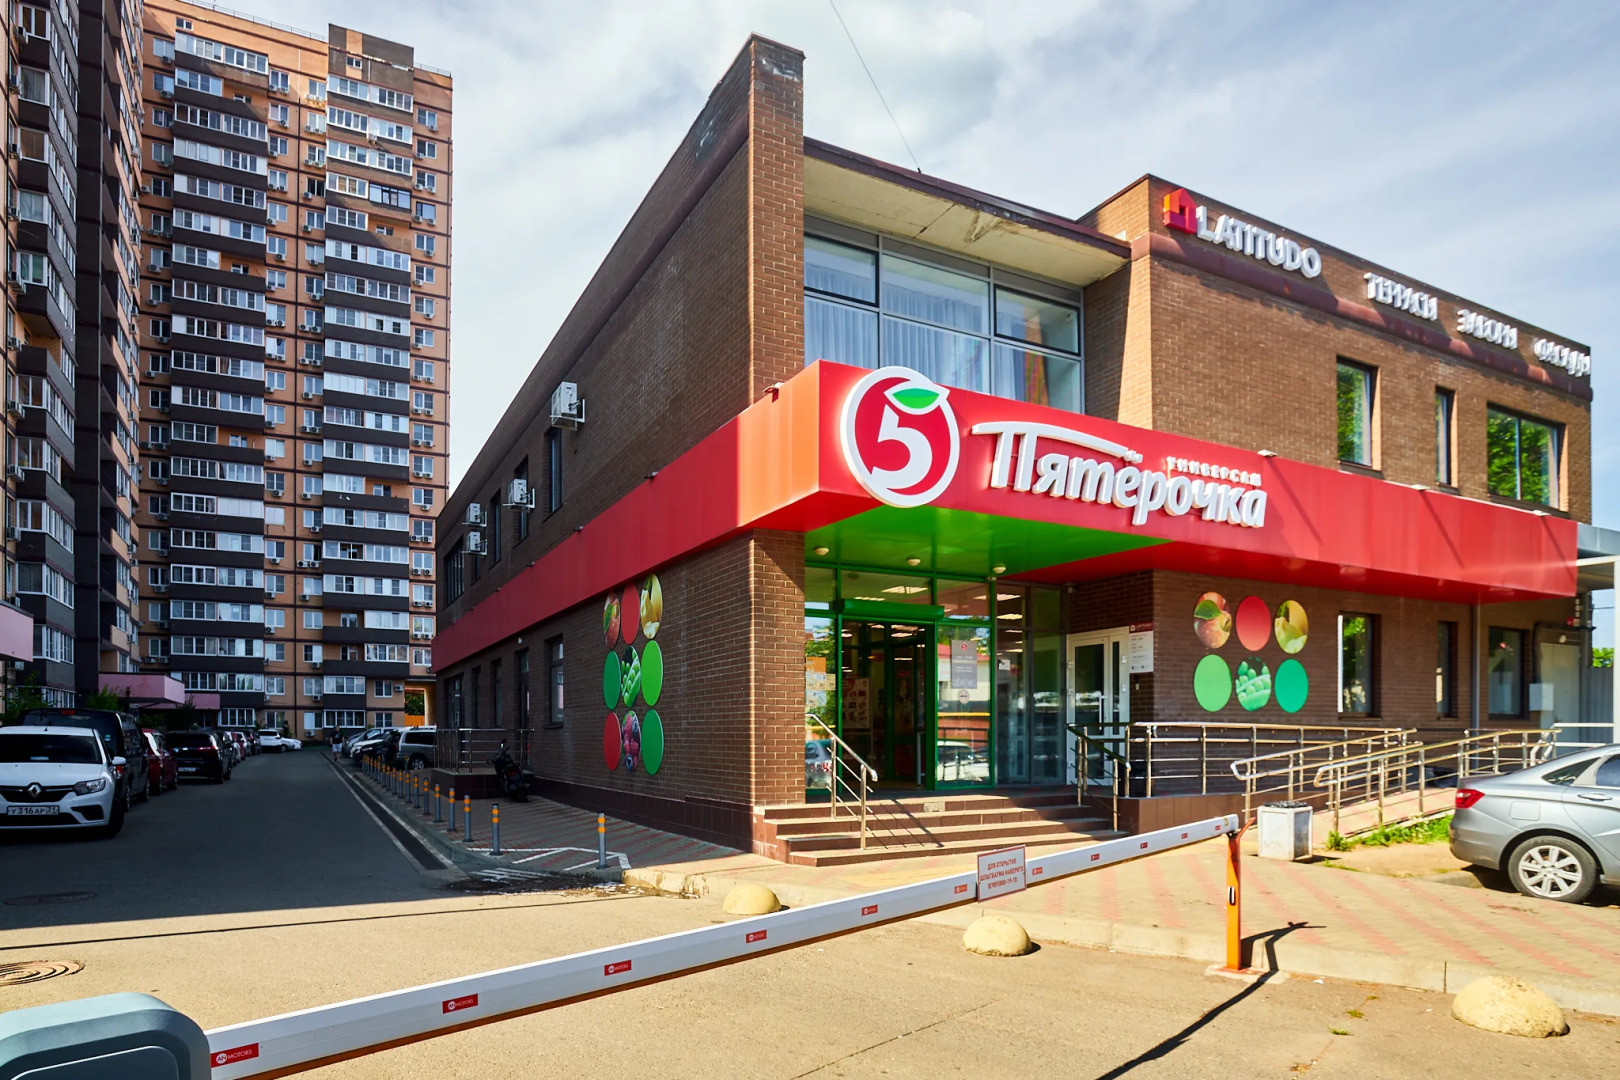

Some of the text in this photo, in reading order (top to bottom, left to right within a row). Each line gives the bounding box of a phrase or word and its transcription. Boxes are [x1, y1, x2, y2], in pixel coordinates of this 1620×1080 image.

[1196, 206, 1322, 278] LATITUDO
[1363, 272, 1438, 321] ТЕРРАСЫ
[1456, 309, 1518, 350] ЗАБОРЫ
[871, 404, 933, 489] 5
[971, 421, 1267, 528] Пятёрочка
[227, 1049, 253, 1060] MOTORS
